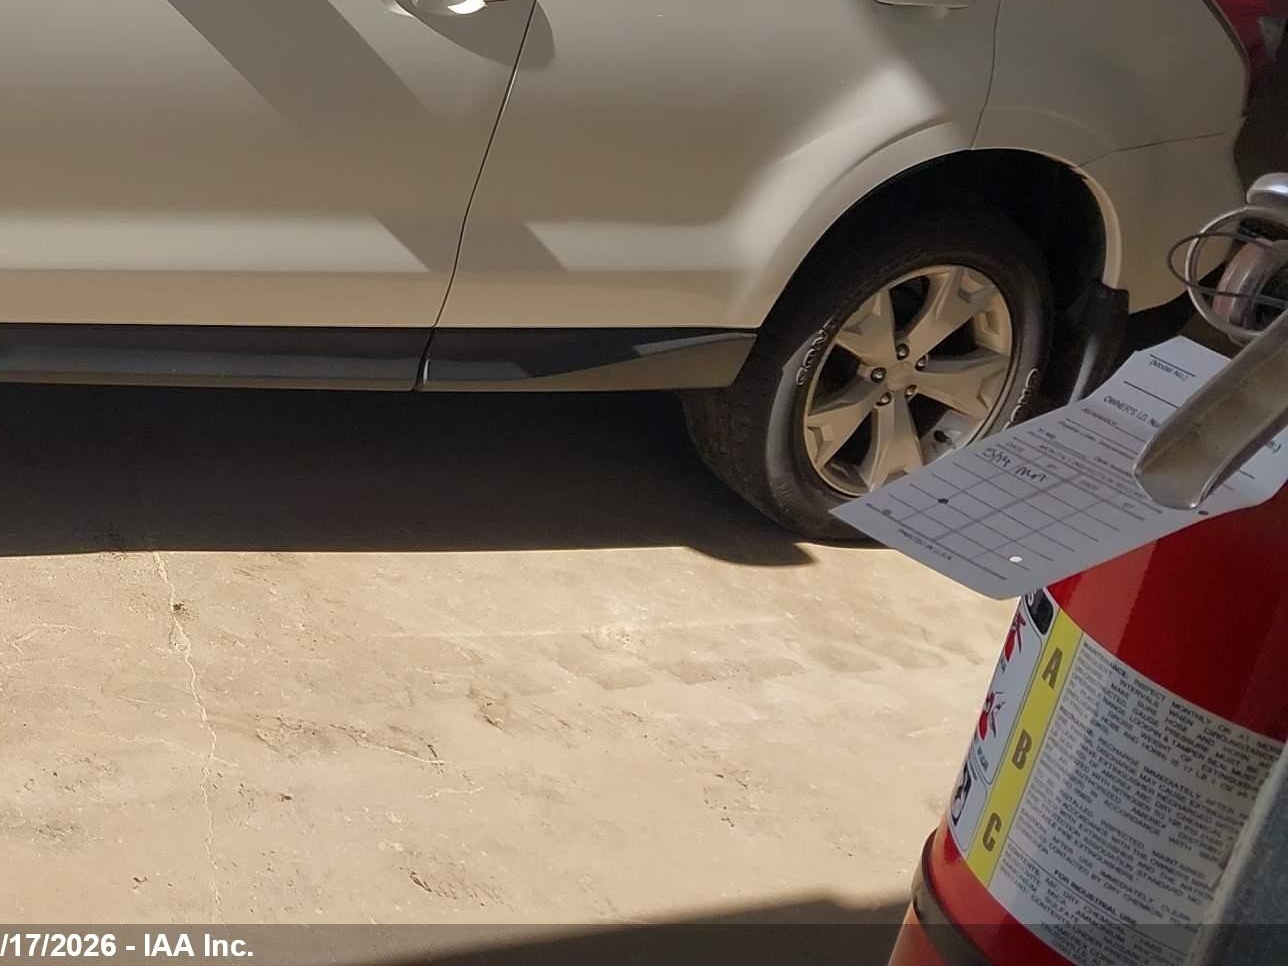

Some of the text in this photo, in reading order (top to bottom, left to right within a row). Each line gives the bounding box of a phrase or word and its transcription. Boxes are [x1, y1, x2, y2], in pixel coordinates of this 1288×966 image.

[1042, 647, 1064, 689] A
[1011, 728, 1033, 771] B
[981, 812, 1003, 853] C
